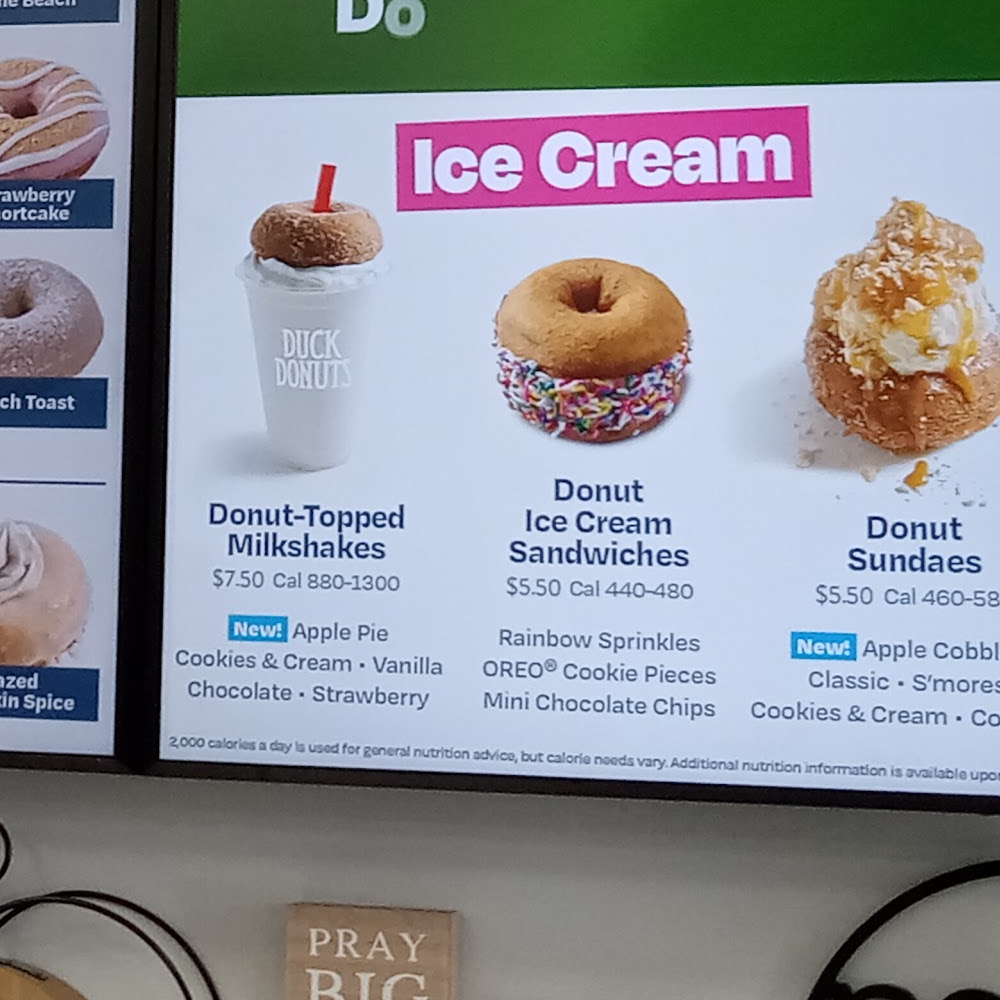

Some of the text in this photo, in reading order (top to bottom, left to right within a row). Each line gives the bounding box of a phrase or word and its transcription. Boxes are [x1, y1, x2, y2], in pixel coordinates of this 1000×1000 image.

[413, 129, 793, 195] Ice Cream
[282, 328, 342, 359] DUCK
[274, 357, 352, 390] DONUTS
[25, 394, 76, 411] Toast
[554, 478, 644, 502] Donut
[209, 503, 405, 533] Donut-Topped
[525, 509, 672, 535] Ice Cream
[867, 516, 963, 541] Donut
[228, 533, 386, 560] Milkshakes
[509, 539, 690, 567] Sandwiches
[848, 547, 982, 573] Sundaes
[212, 568, 401, 591] $7.50 Cal 880-1300
[506, 576, 694, 600] $5.50 Cal 440-480
[816, 584, 916, 606] $5.50 Cal
[233, 621, 389, 644] New! Apple Pie
[499, 628, 700, 653] Rainbow Sprinkles
[175, 649, 443, 675] Cookies Cream Vanilla
[796, 638, 927, 662] New! Apple
[563, 662, 717, 685] Cookie Pieces
[808, 670, 890, 690] Classic
[23, 693, 75, 713] Spice
[188, 680, 430, 710] Chocolate Strawberry
[483, 691, 716, 720] Mini Chocolate Chips
[751, 701, 948, 726] Cookies Cream
[208, 737, 968, 780] calories used general nutrition advice, calorie needs Additional nutrition information available
[309, 928, 427, 962] PRAY
[306, 968, 429, 1000] BIG
